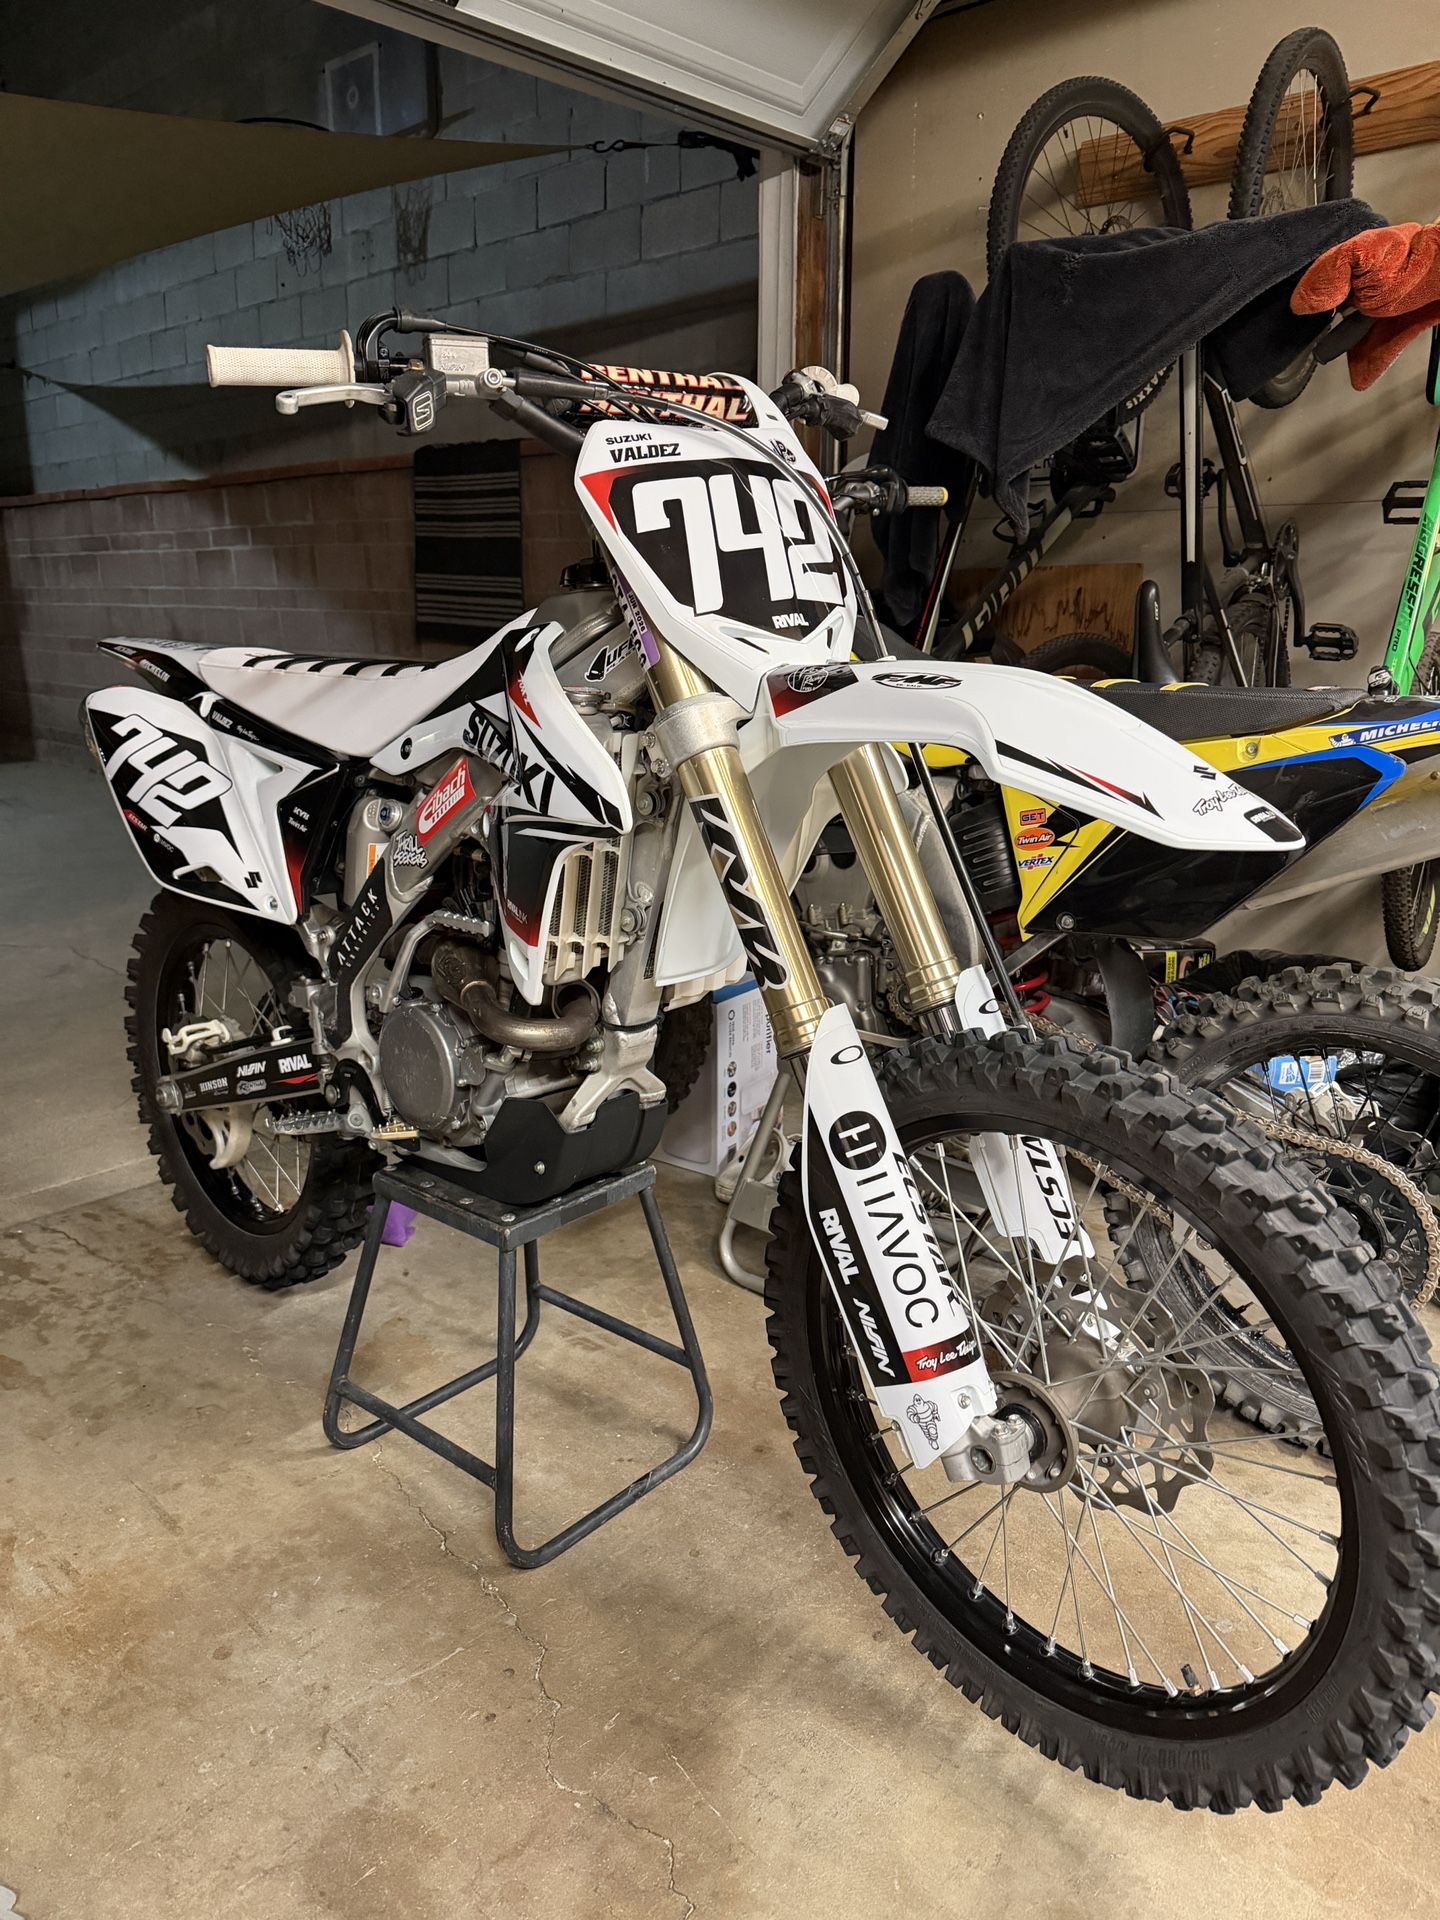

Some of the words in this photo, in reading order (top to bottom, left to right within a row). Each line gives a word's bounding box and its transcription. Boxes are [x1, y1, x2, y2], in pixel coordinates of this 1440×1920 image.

[605, 433, 652, 445] SUZUKI
[610, 443, 681, 463] VALDEZ
[631, 474, 846, 616] 742
[771, 612, 810, 629] RIVAL
[104, 713, 233, 829] 742
[418, 767, 466, 834] Eibach
[1192, 798, 1223, 816] Troy
[1021, 812, 1044, 822] GET
[1017, 836, 1038, 846] Twin
[1038, 833, 1053, 843] Air
[1018, 856, 1055, 867] VERTEX
[336, 888, 378, 966] ATTACK
[278, 1054, 313, 1074] RIVAL
[200, 1077, 228, 1093] HINSON
[1020, 1135, 1080, 1242] ECSTA
[820, 1208, 861, 1285] RIVAL
[916, 1356, 938, 1372] Troy
[940, 1352, 958, 1364] Lee
